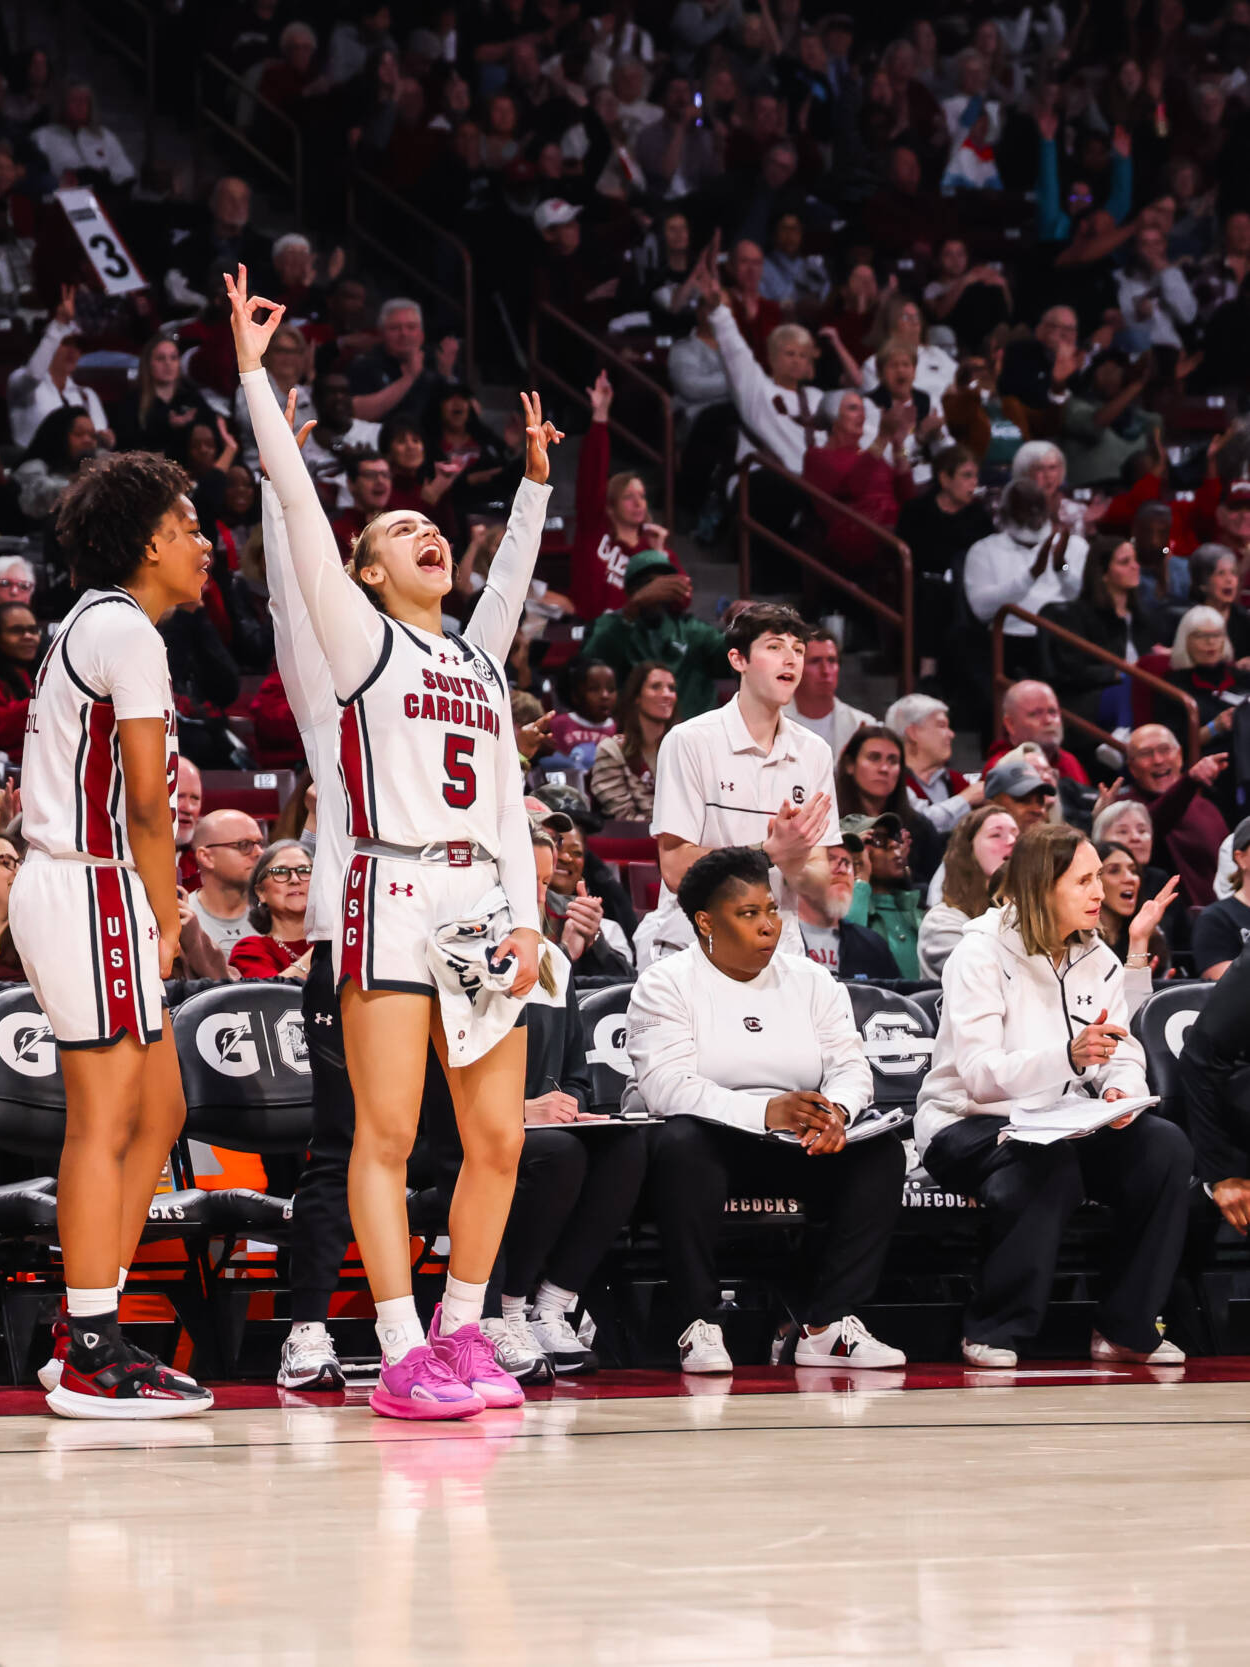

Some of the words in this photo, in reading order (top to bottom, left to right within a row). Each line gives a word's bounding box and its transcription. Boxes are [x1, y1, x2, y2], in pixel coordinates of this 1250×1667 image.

[90, 235, 129, 278] 3
[422, 668, 489, 704] SOUTH
[404, 693, 500, 741] CAROLINA
[442, 732, 476, 810] 5
[345, 869, 362, 947] USC
[106, 916, 128, 999] USC
[724, 1197, 799, 1213] ECOCKS
